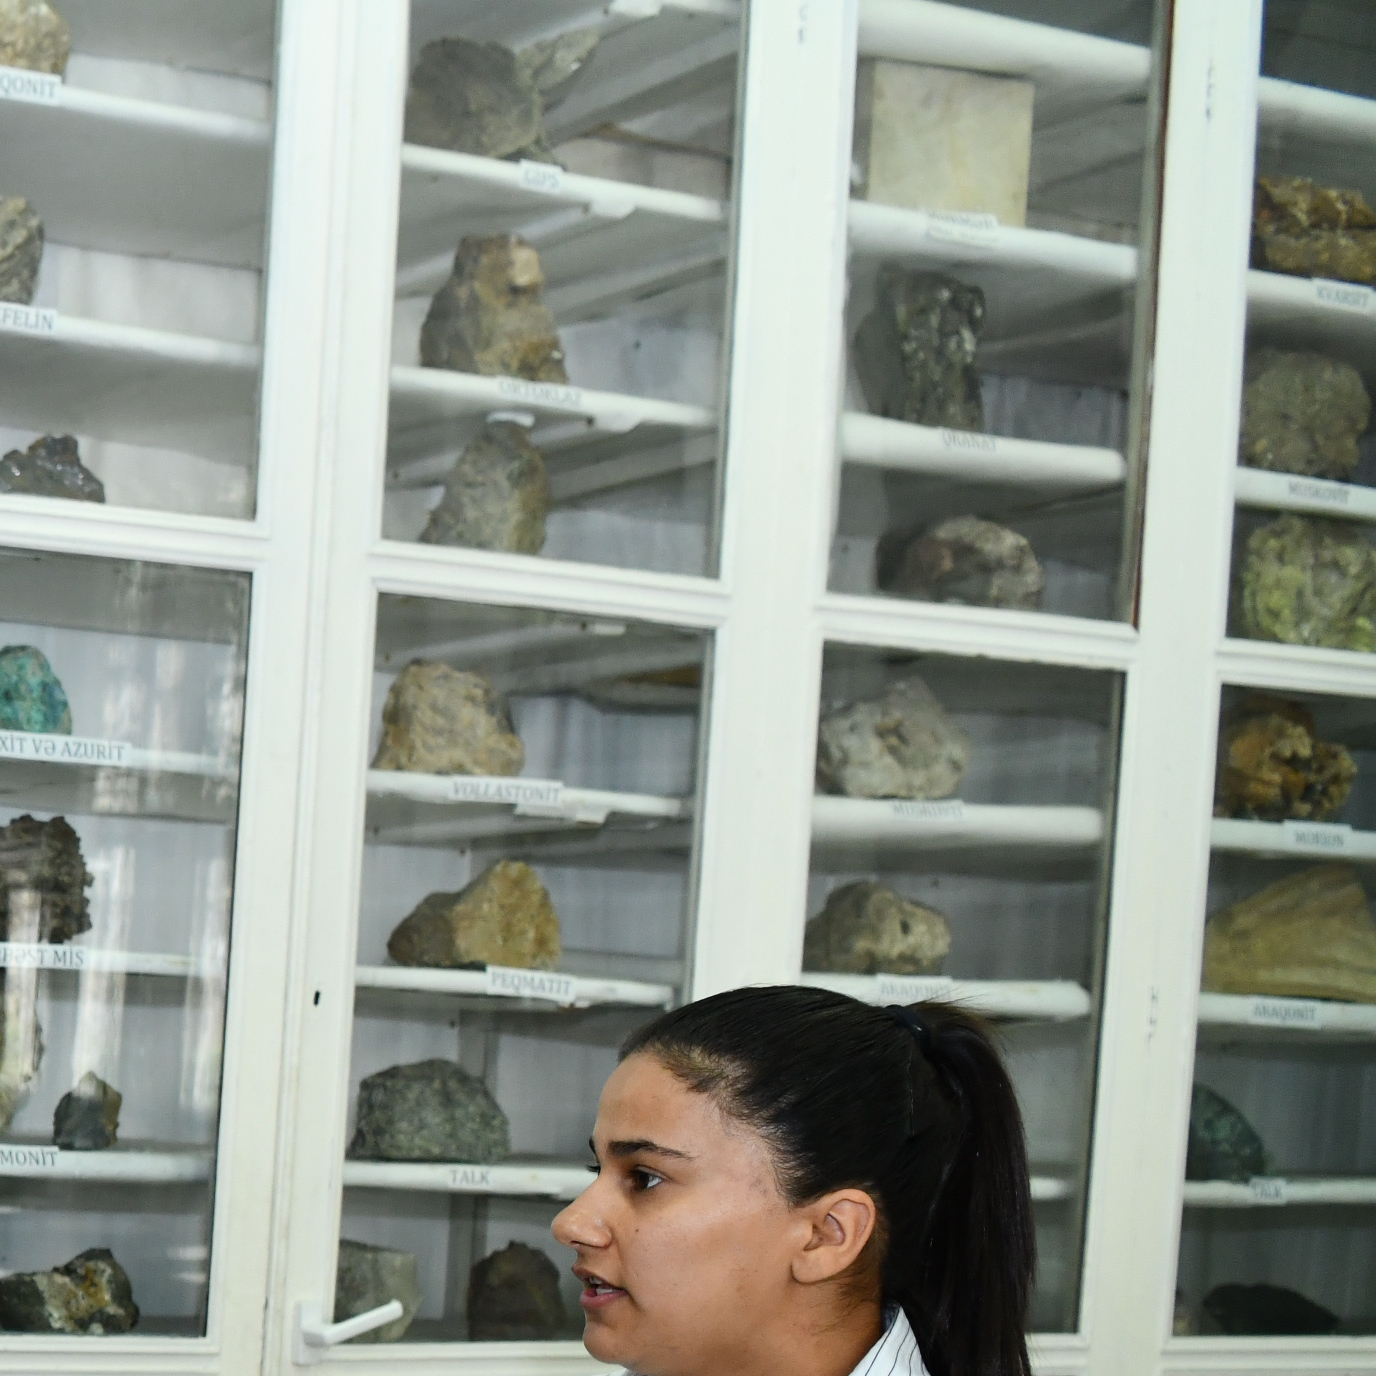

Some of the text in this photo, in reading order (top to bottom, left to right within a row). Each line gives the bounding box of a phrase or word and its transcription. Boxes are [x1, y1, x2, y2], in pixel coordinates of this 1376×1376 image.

[32, 737, 56, 757] VƏ
[60, 742, 126, 763] AZURİT
[52, 948, 85, 968] MİS
[449, 1169, 490, 1186] TALK
